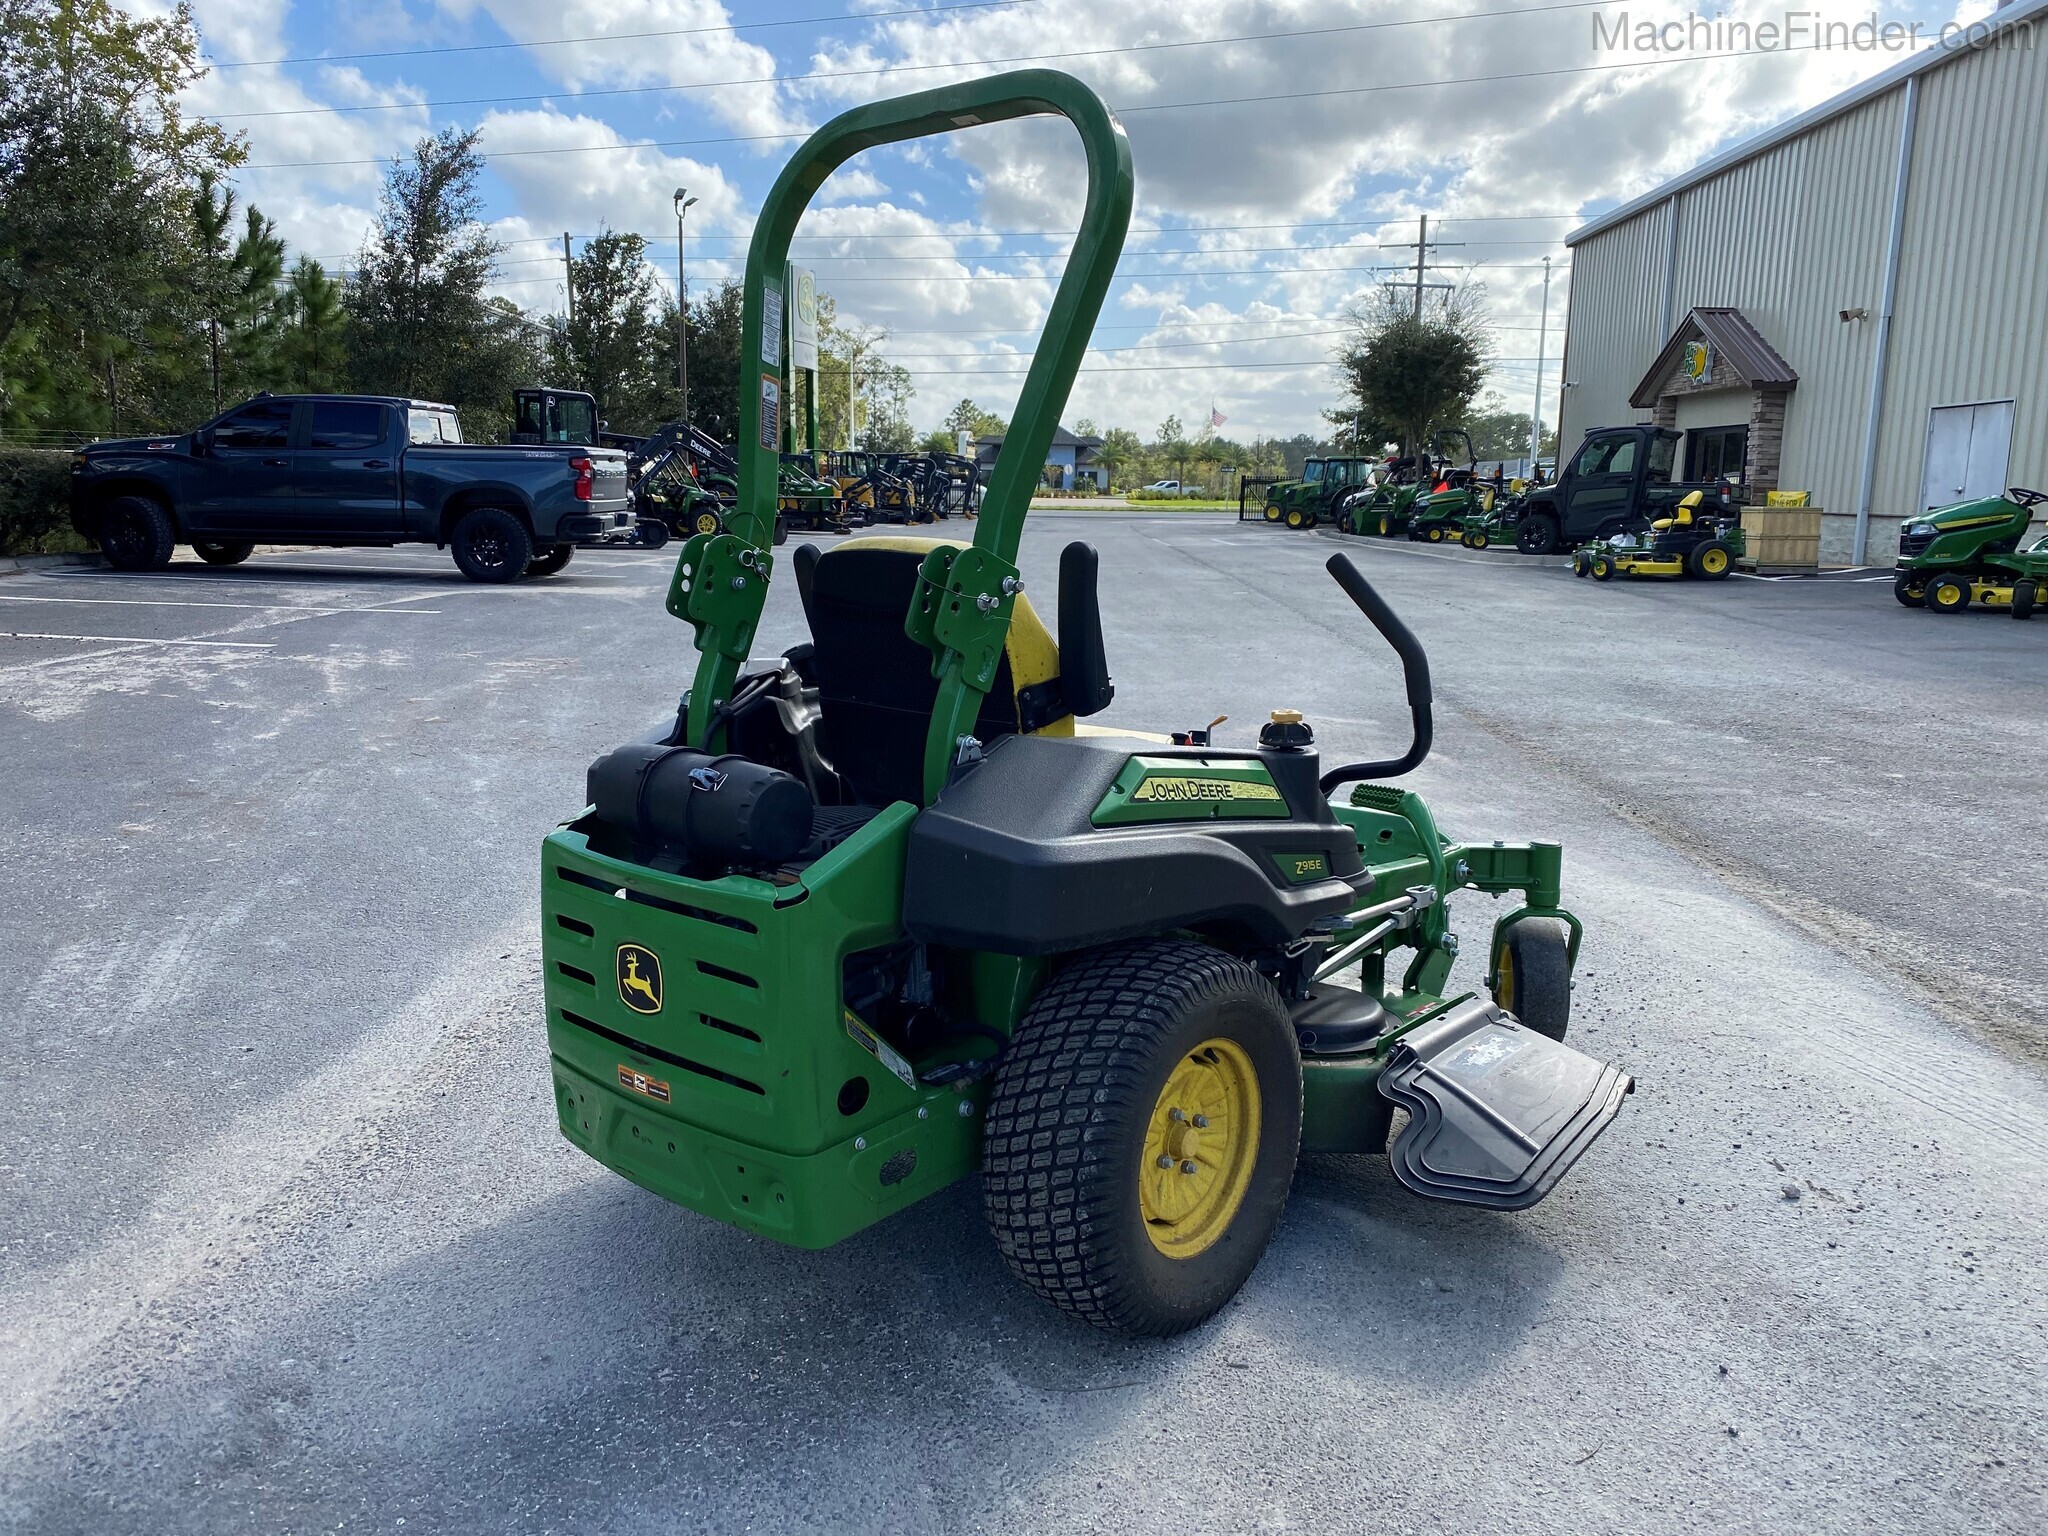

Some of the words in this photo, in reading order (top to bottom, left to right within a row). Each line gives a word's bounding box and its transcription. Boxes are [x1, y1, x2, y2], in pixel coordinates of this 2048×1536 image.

[690, 439, 712, 458] DEERE
[1149, 780, 1188, 801] JOHN
[1189, 780, 1234, 799] DEERE
[1295, 859, 1322, 875] Z915E
